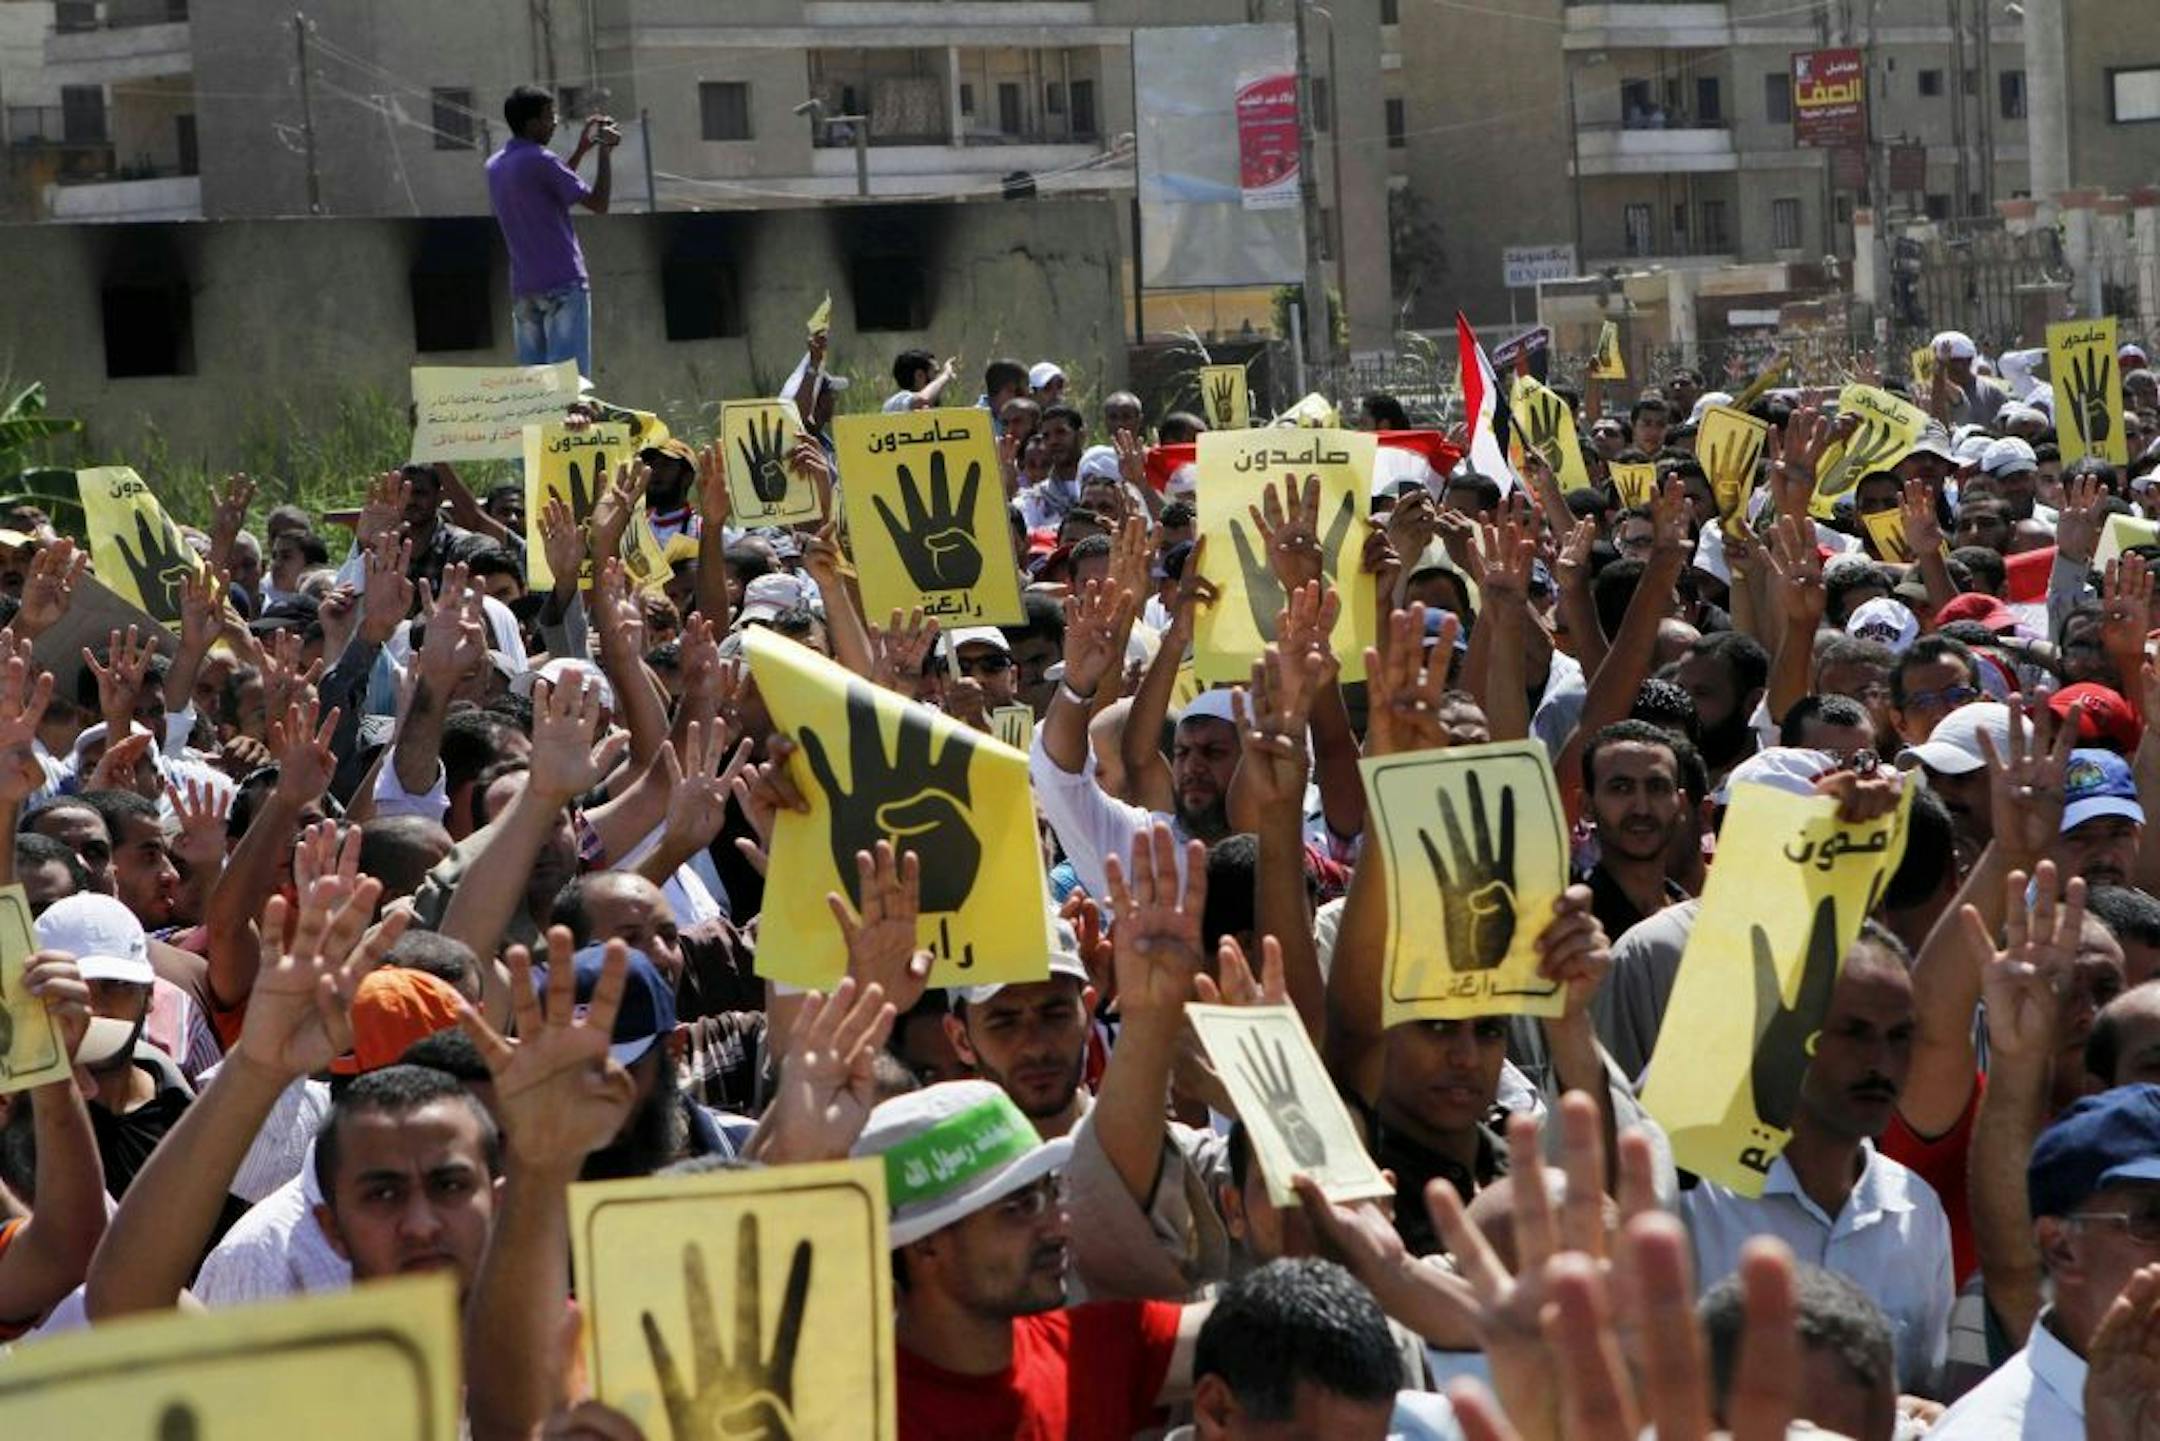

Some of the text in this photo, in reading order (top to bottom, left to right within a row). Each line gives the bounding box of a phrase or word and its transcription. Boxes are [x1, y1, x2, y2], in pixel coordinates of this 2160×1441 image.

[1795, 78, 1862, 107] الصفا
[549, 429, 620, 453] صامدون
[868, 419, 971, 453] صامدون
[1234, 437, 1350, 472] صامدون
[922, 589, 982, 620] رابعة
[1783, 829, 1888, 872] مدون
[930, 1144, 977, 1182] رسول
